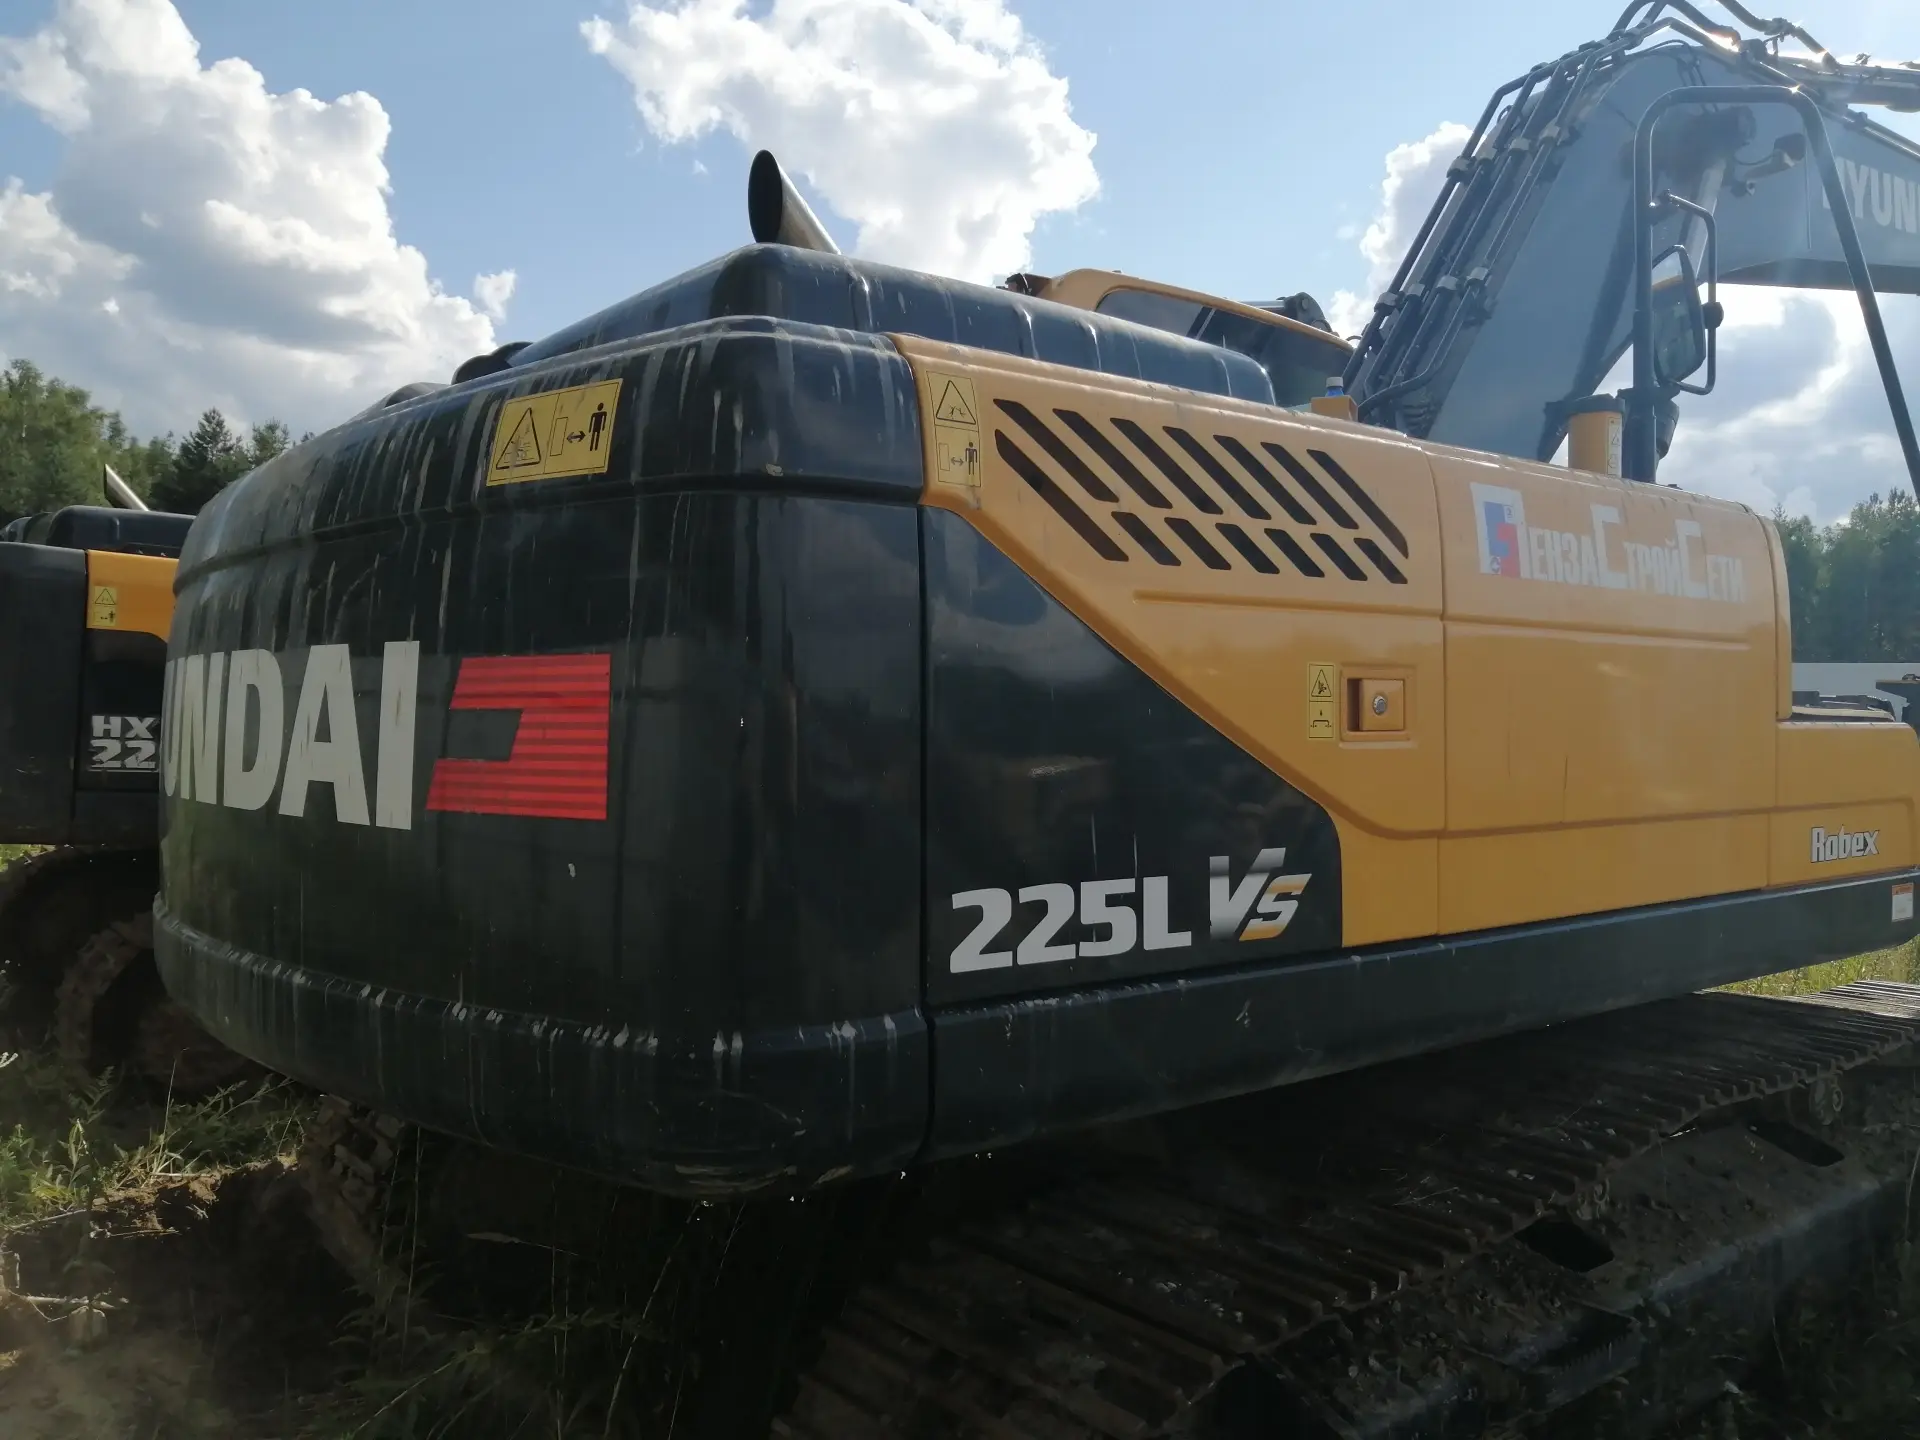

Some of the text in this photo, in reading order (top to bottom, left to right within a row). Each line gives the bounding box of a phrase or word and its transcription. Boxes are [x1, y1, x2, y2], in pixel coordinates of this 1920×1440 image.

[1822, 156, 1920, 234] YUN
[92, 715, 157, 739] HX
[1810, 824, 1880, 863] Robex
[950, 875, 1192, 973] 225L
